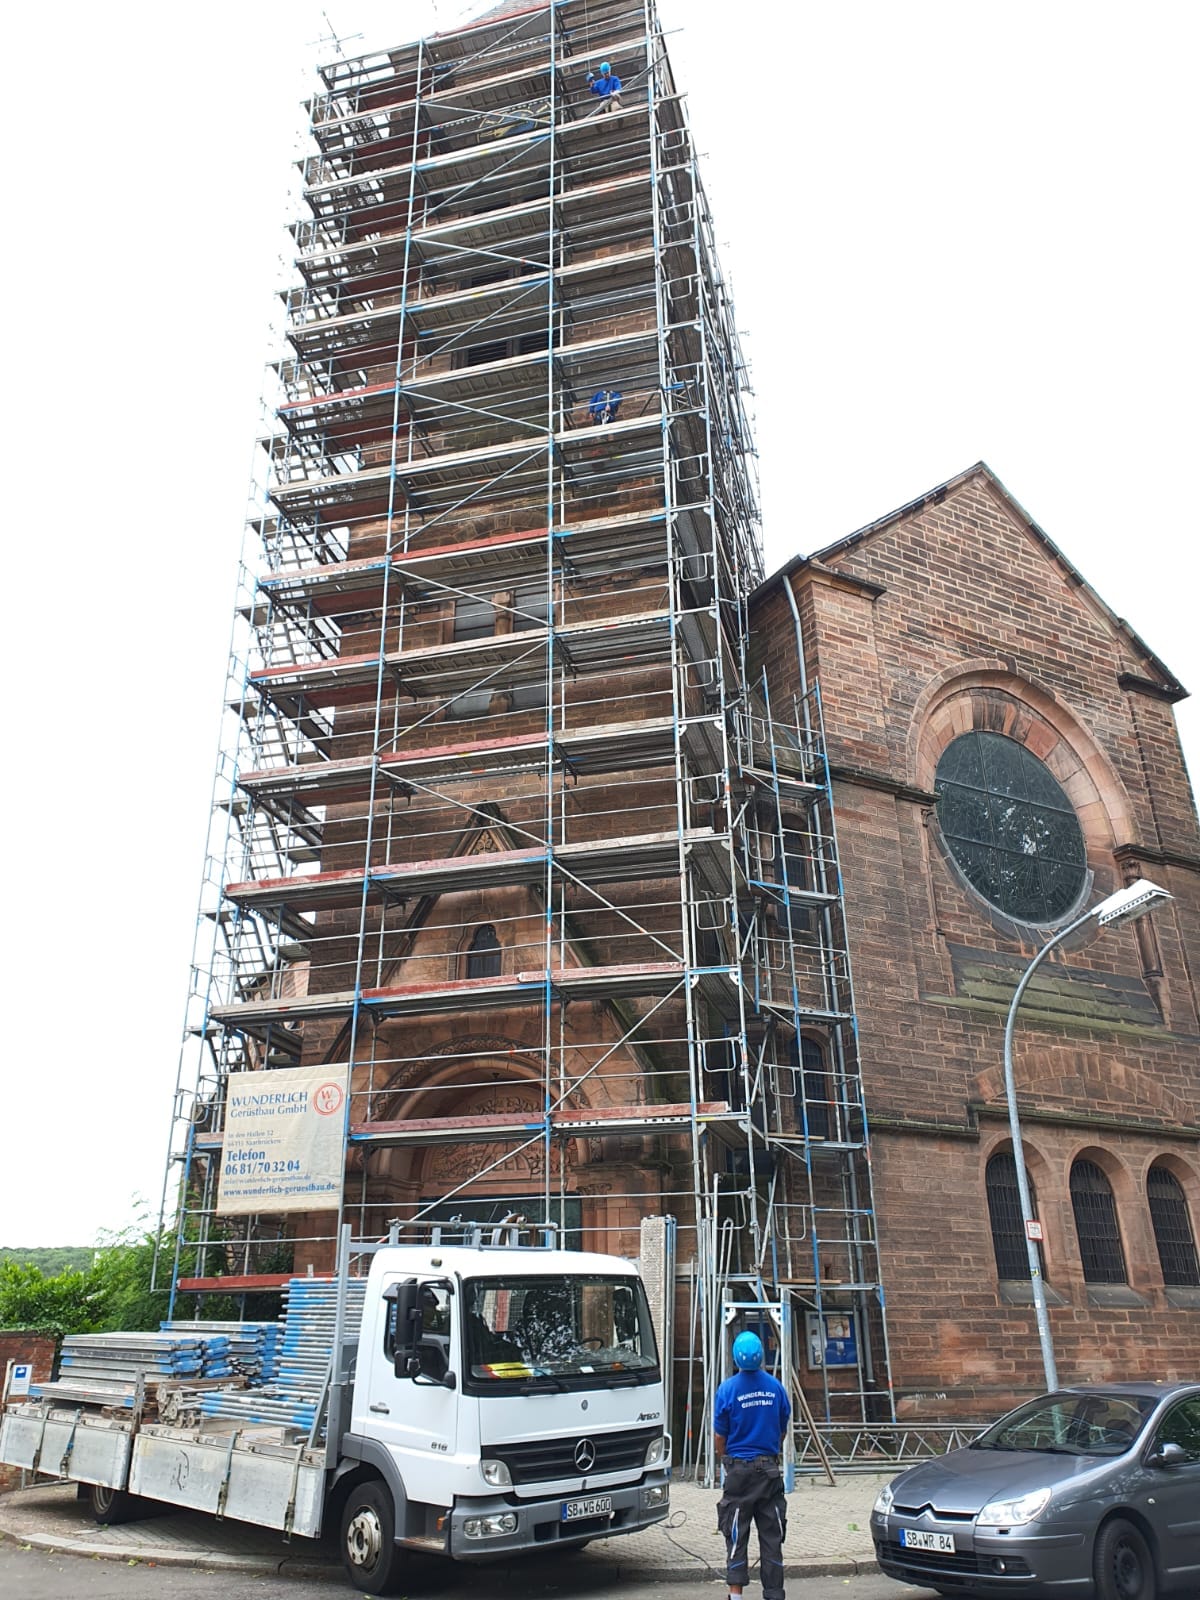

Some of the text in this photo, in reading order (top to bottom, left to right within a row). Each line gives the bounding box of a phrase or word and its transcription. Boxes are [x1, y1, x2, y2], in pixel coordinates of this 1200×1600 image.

[231, 1091, 308, 1107] WUNDERLICH
[321, 1089, 333, 1100] W
[230, 1104, 307, 1118] Gerüstbau GmbH
[325, 1100, 334, 1110] G
[226, 1148, 266, 1161] Telefon
[223, 1182, 336, 1197] www.wunderlich-geruestbau.de
[737, 1391, 775, 1401] WUNDERLICH
